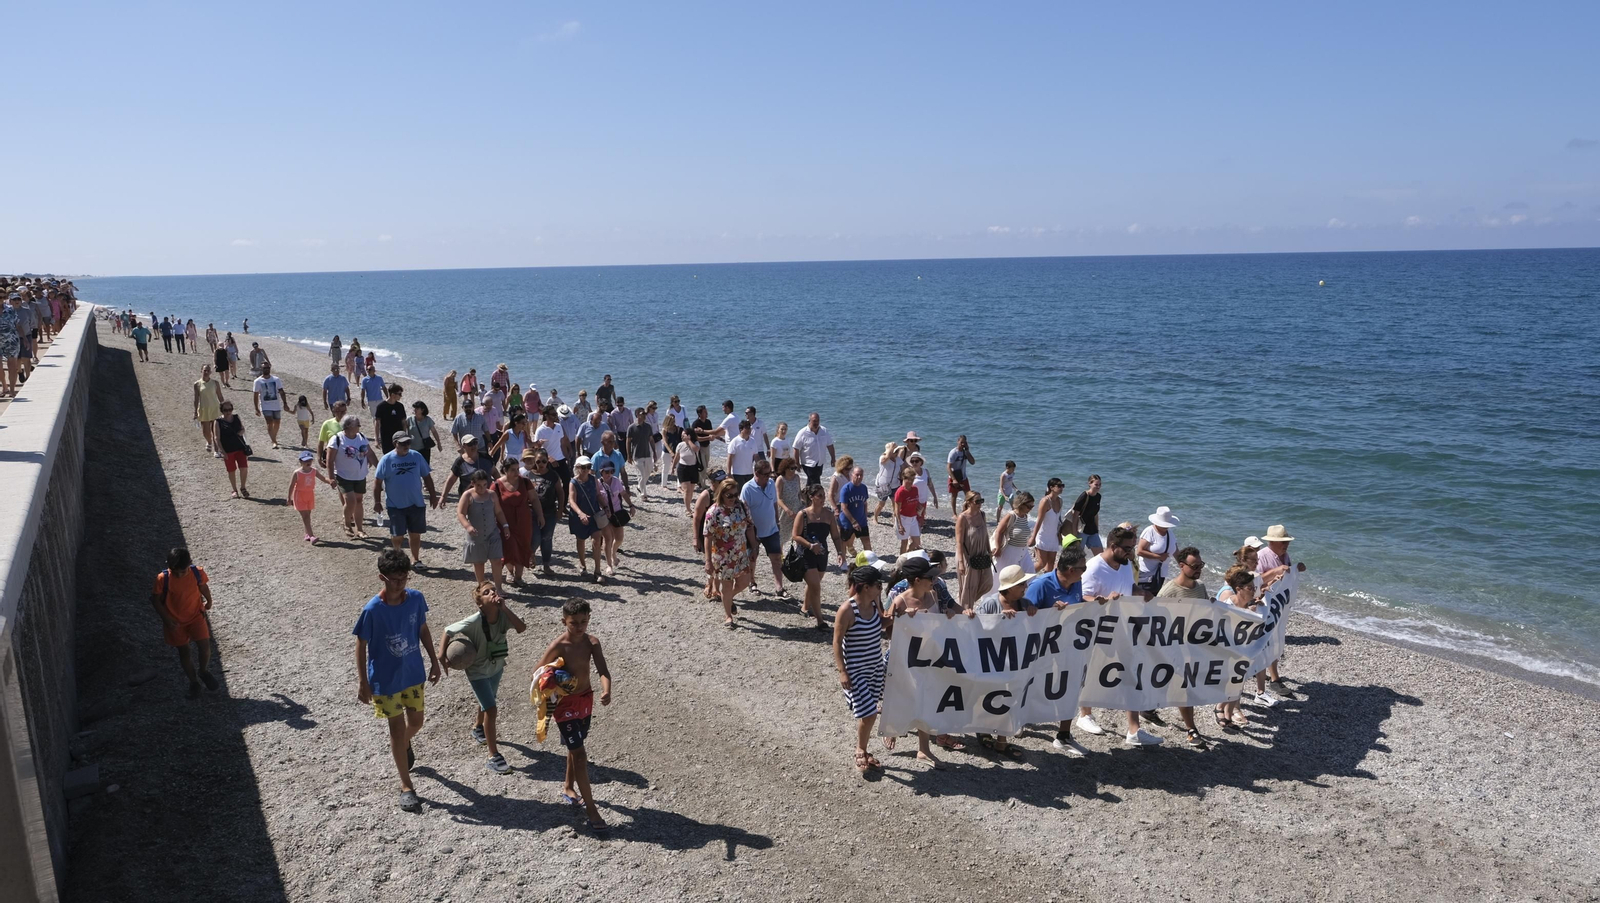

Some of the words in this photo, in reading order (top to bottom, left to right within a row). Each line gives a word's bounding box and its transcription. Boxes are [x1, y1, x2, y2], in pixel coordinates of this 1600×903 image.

[907, 636, 967, 674] LA
[978, 624, 1062, 674] MAR
[1073, 615, 1119, 650] SE
[1127, 615, 1231, 647] TRAGA
